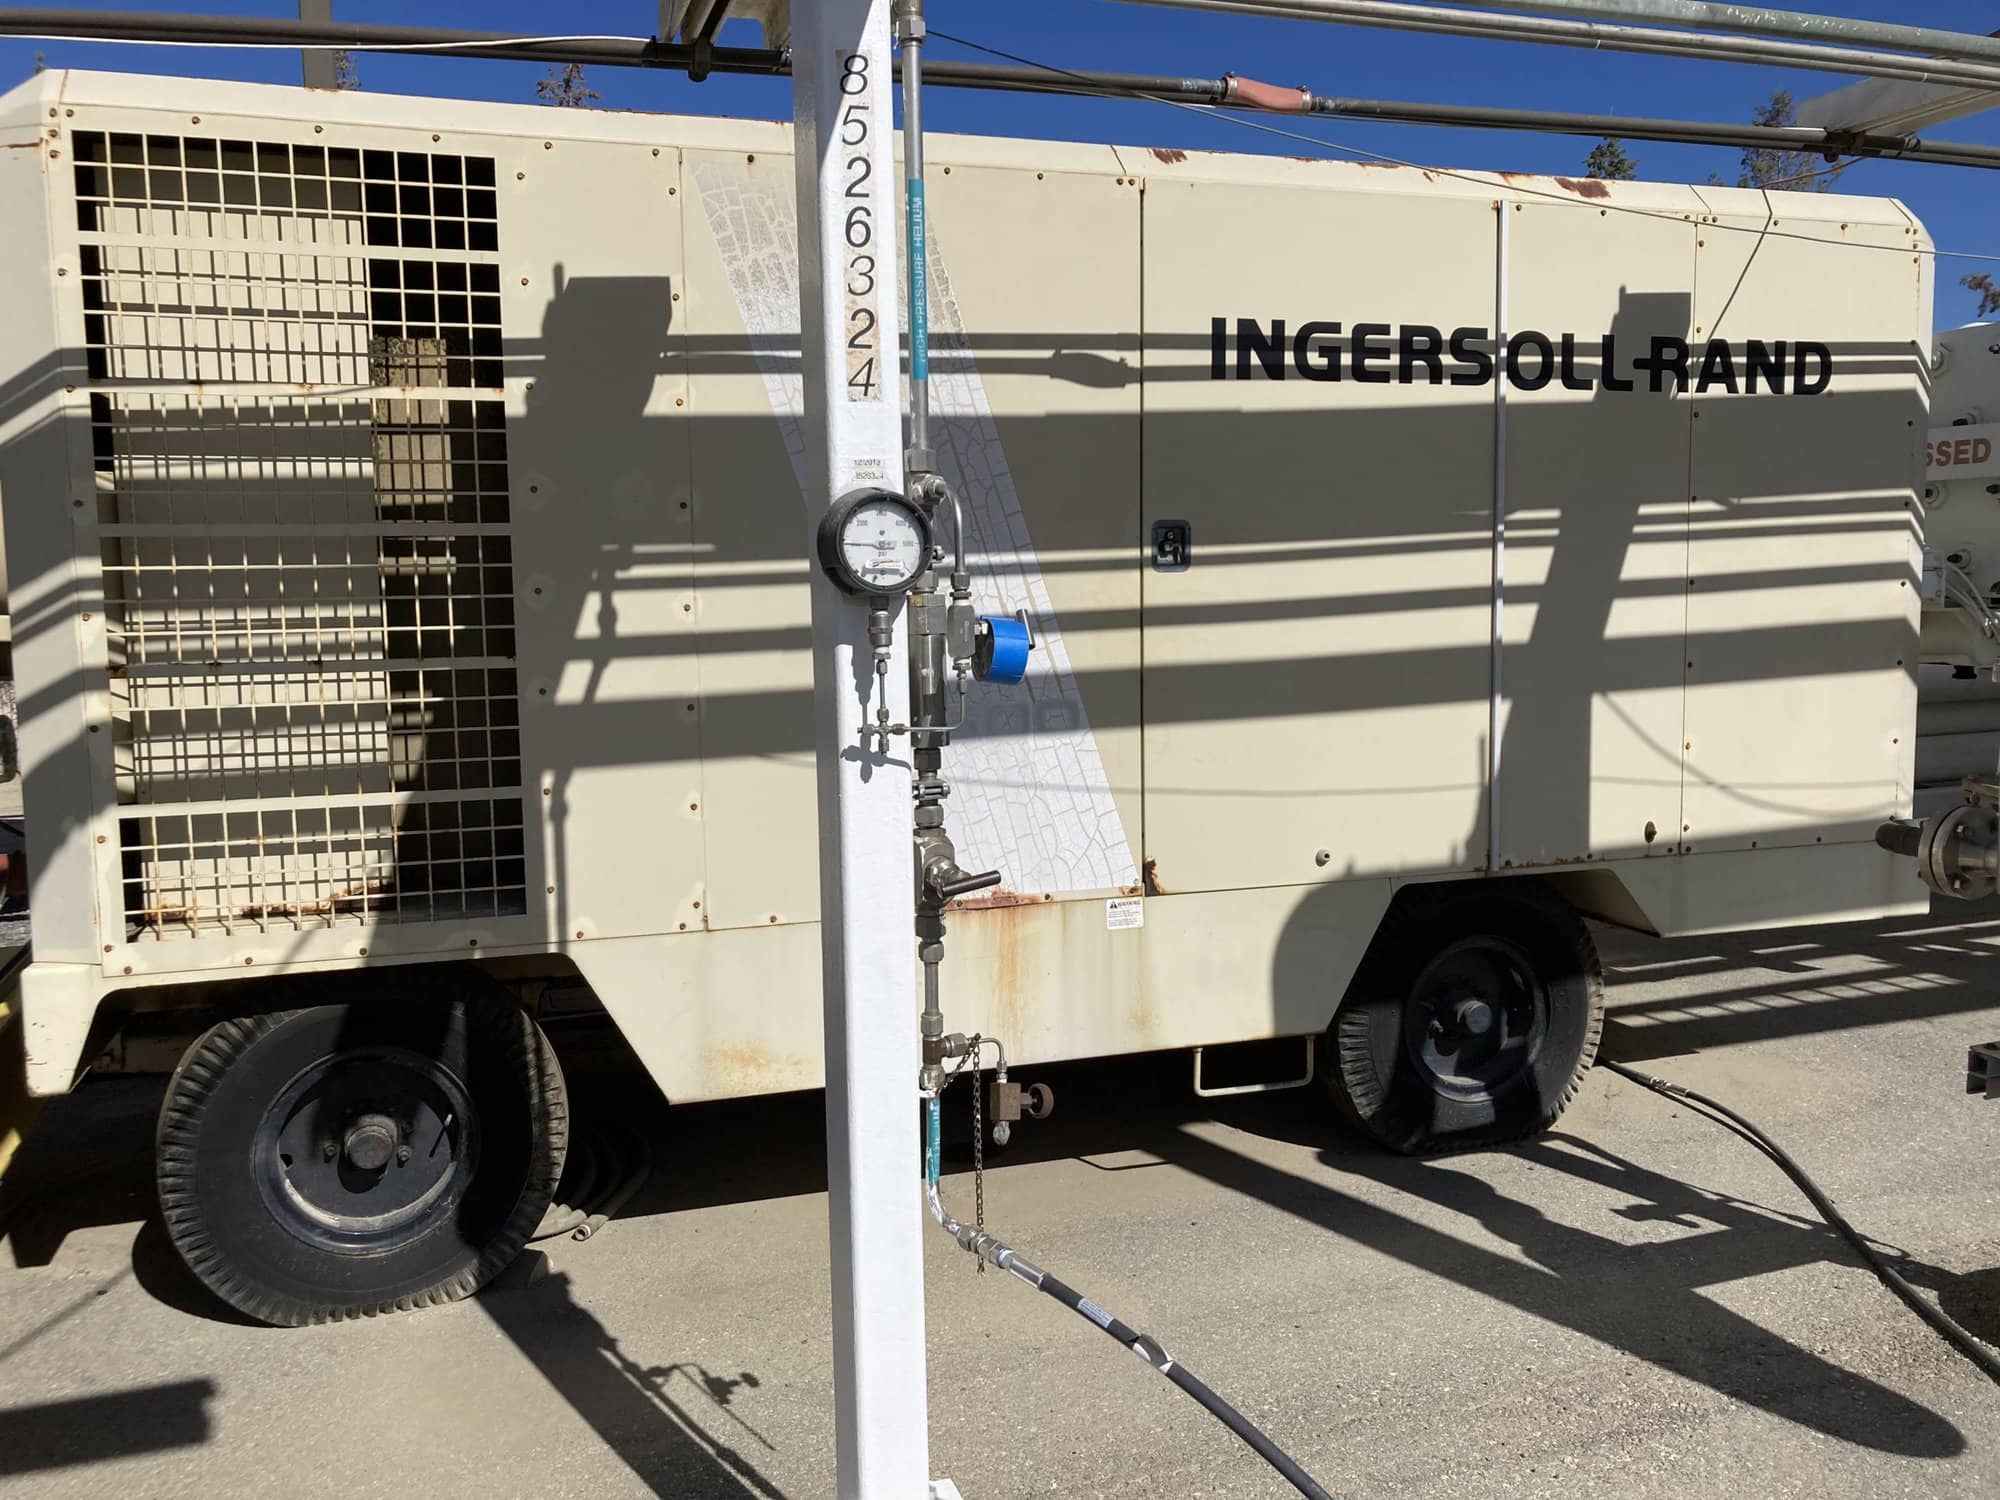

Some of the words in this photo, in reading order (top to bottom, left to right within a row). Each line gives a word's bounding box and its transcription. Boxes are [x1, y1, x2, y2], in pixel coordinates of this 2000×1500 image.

[839, 54, 876, 397] 8526324
[912, 196, 923, 247] HELIUM
[1211, 317, 1832, 396] INGERSOLL-RAND
